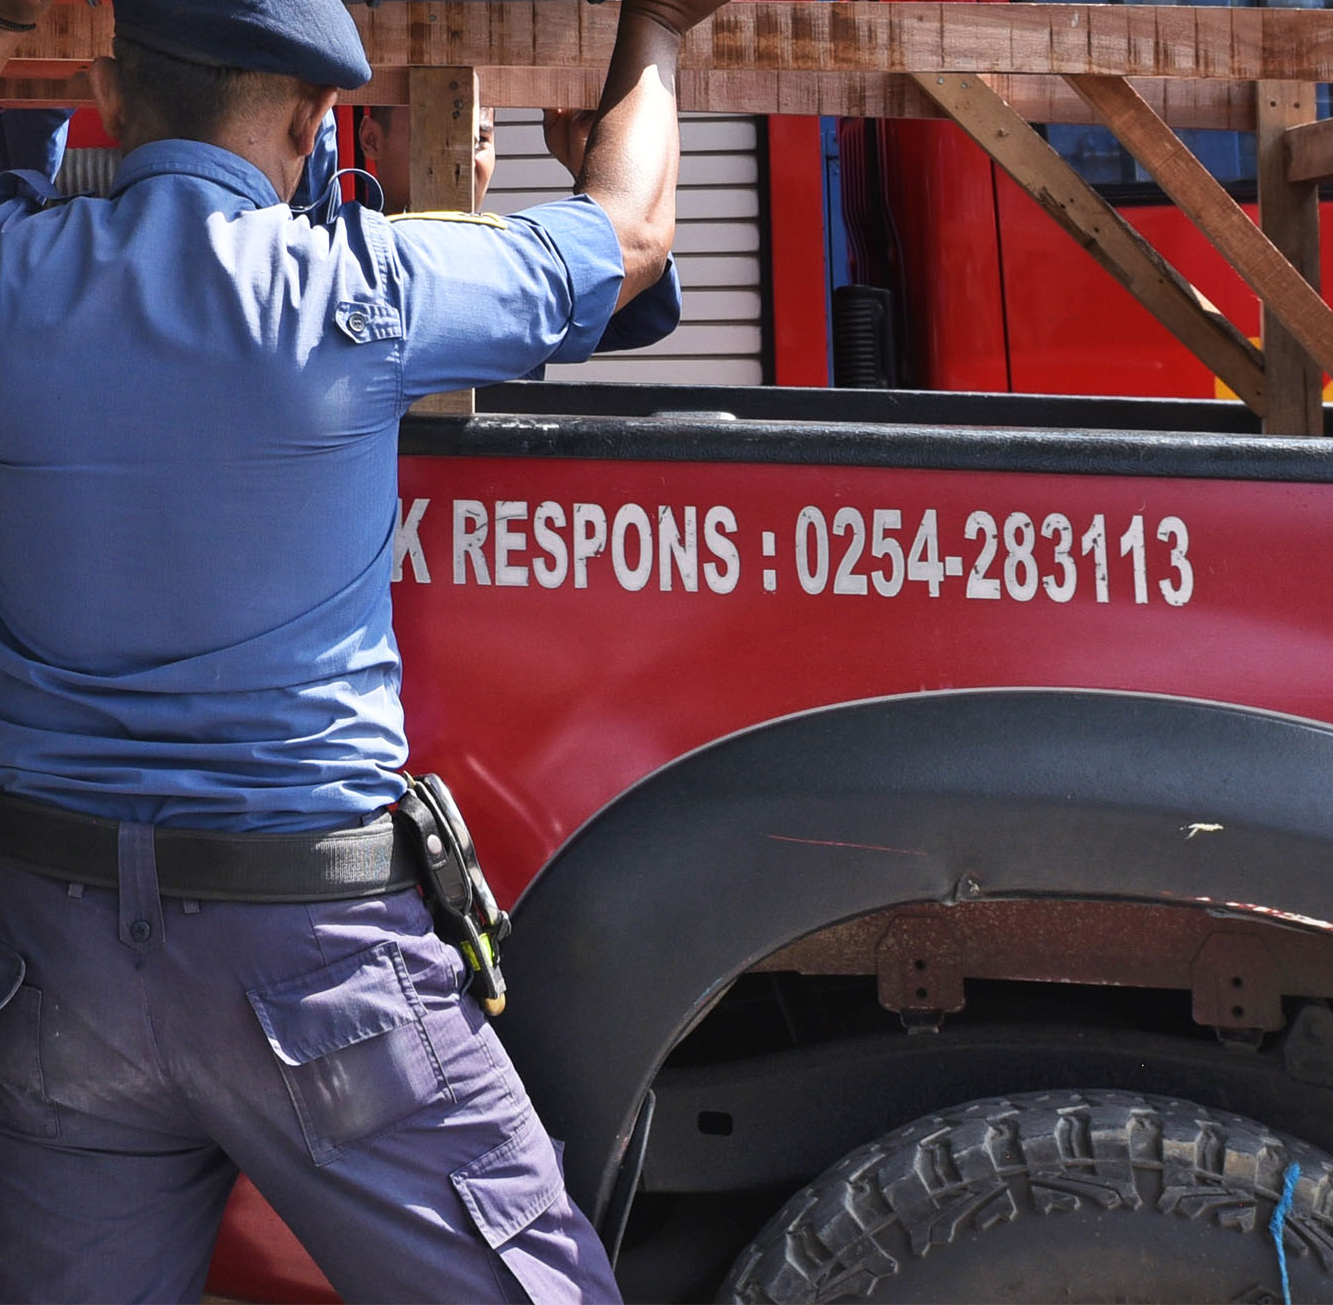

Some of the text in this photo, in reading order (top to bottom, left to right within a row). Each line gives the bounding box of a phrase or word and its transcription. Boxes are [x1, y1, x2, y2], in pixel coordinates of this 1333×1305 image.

[390, 498, 431, 584] K
[452, 499, 740, 595] RESPONS
[795, 505, 1194, 607] 0254-283113
